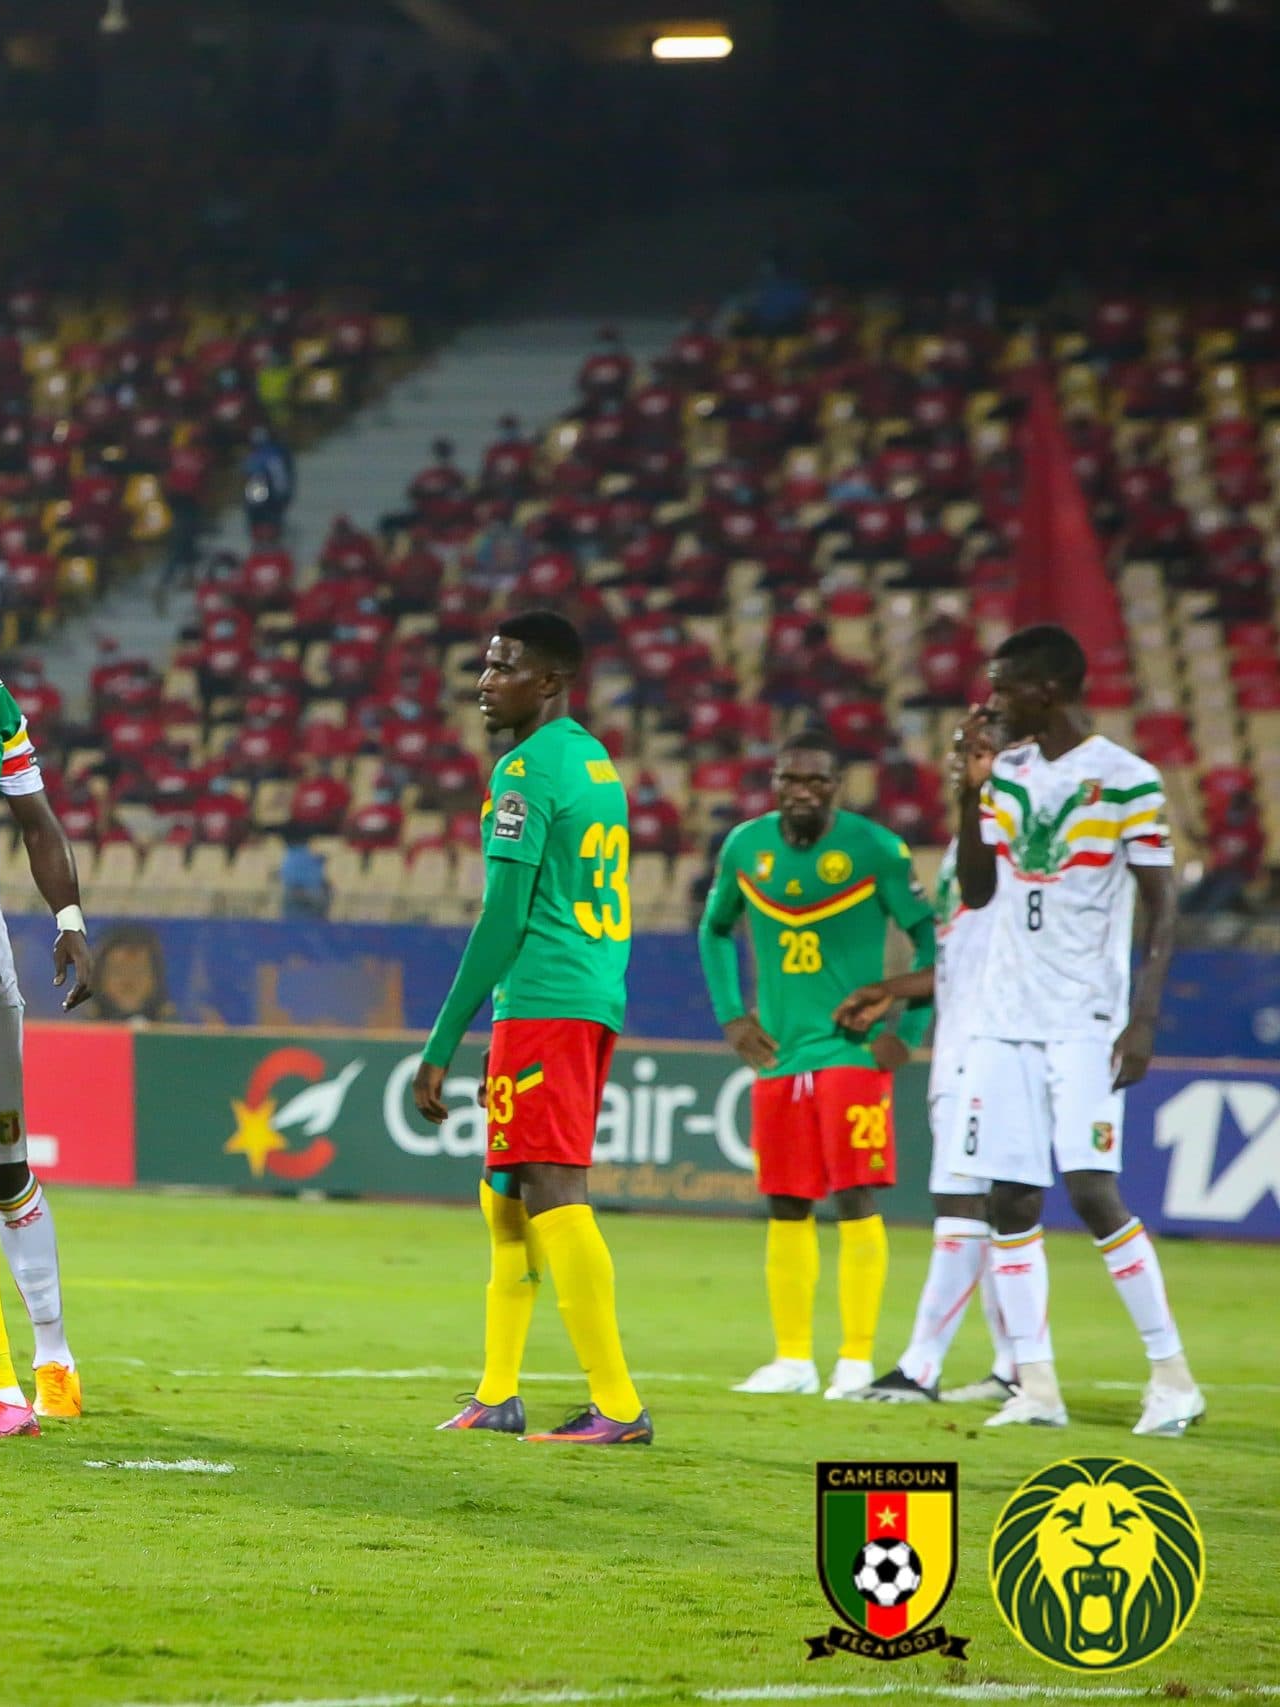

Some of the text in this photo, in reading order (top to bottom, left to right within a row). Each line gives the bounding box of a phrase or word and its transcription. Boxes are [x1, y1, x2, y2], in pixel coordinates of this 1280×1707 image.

[574, 822, 631, 942] 33
[1027, 889, 1043, 931] 8
[778, 929, 823, 974] 28
[846, 1104, 887, 1149] 28
